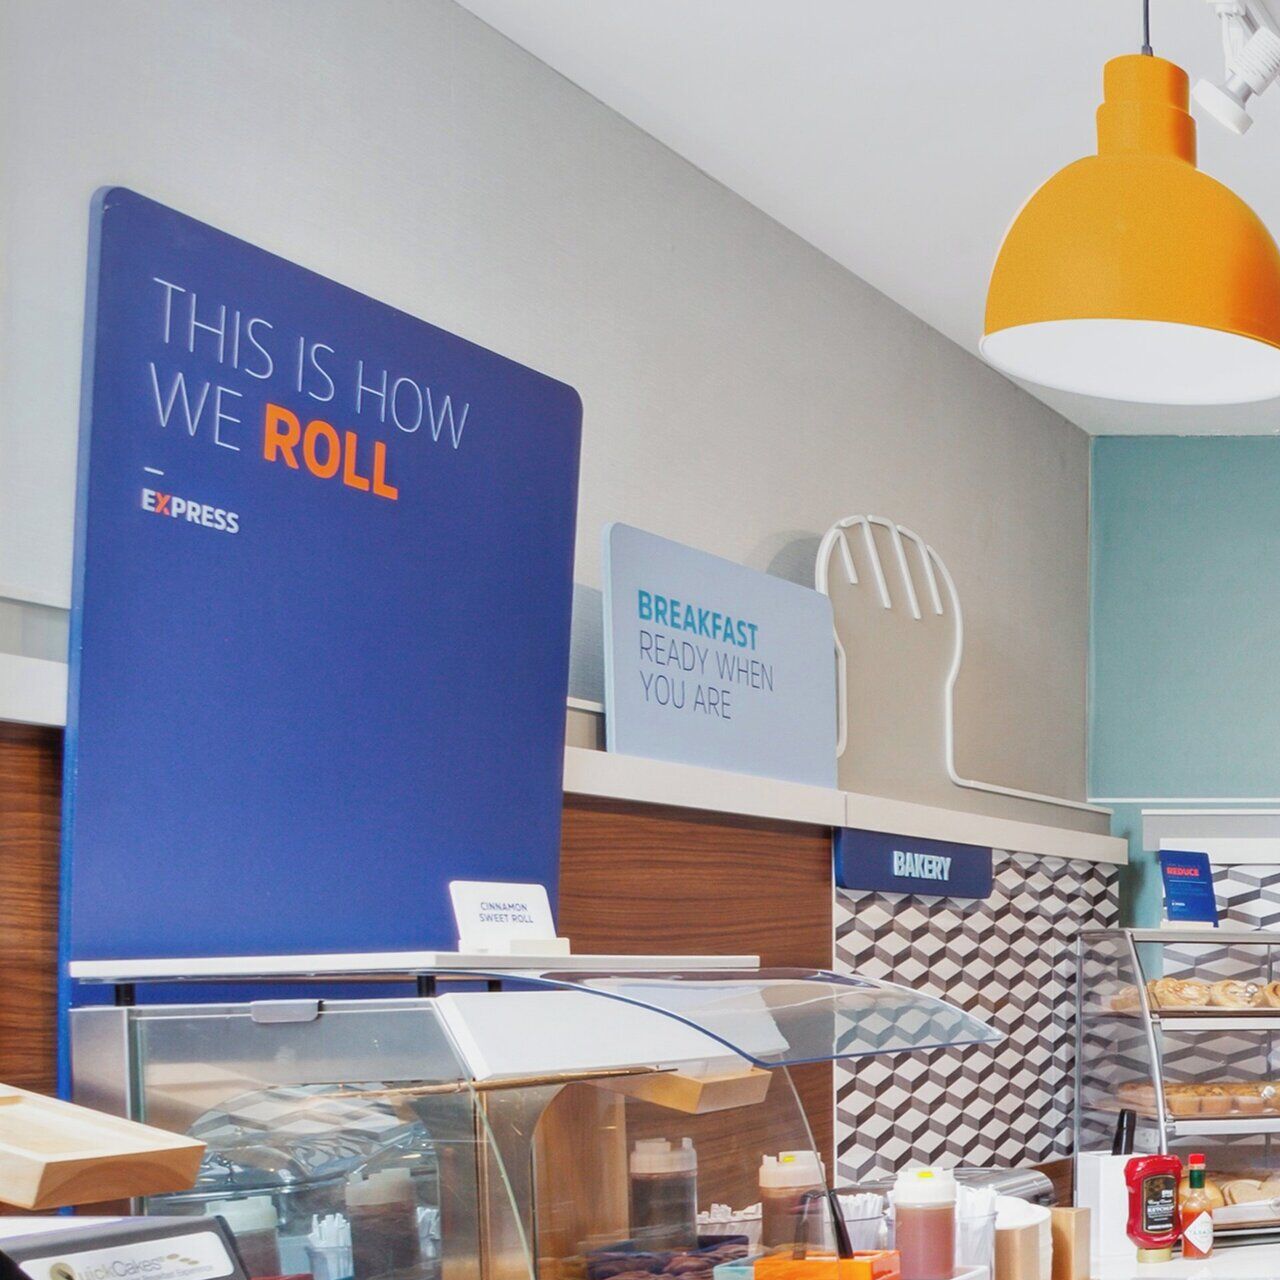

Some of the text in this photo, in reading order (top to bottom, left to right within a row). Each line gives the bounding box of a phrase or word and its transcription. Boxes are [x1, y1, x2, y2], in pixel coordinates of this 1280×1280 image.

[152, 276, 470, 450] THIS IS HOW
[150, 362, 399, 501] WE ROLL
[140, 487, 240, 535] EXPRESS
[637, 589, 759, 651] BREAKFAST
[640, 630, 775, 693] READY WHEN
[639, 670, 733, 721] YOU ARE
[892, 850, 952, 882] BAKERY
[479, 913, 533, 924] SWEET ROLL
[480, 902, 528, 911] CINNAMON
